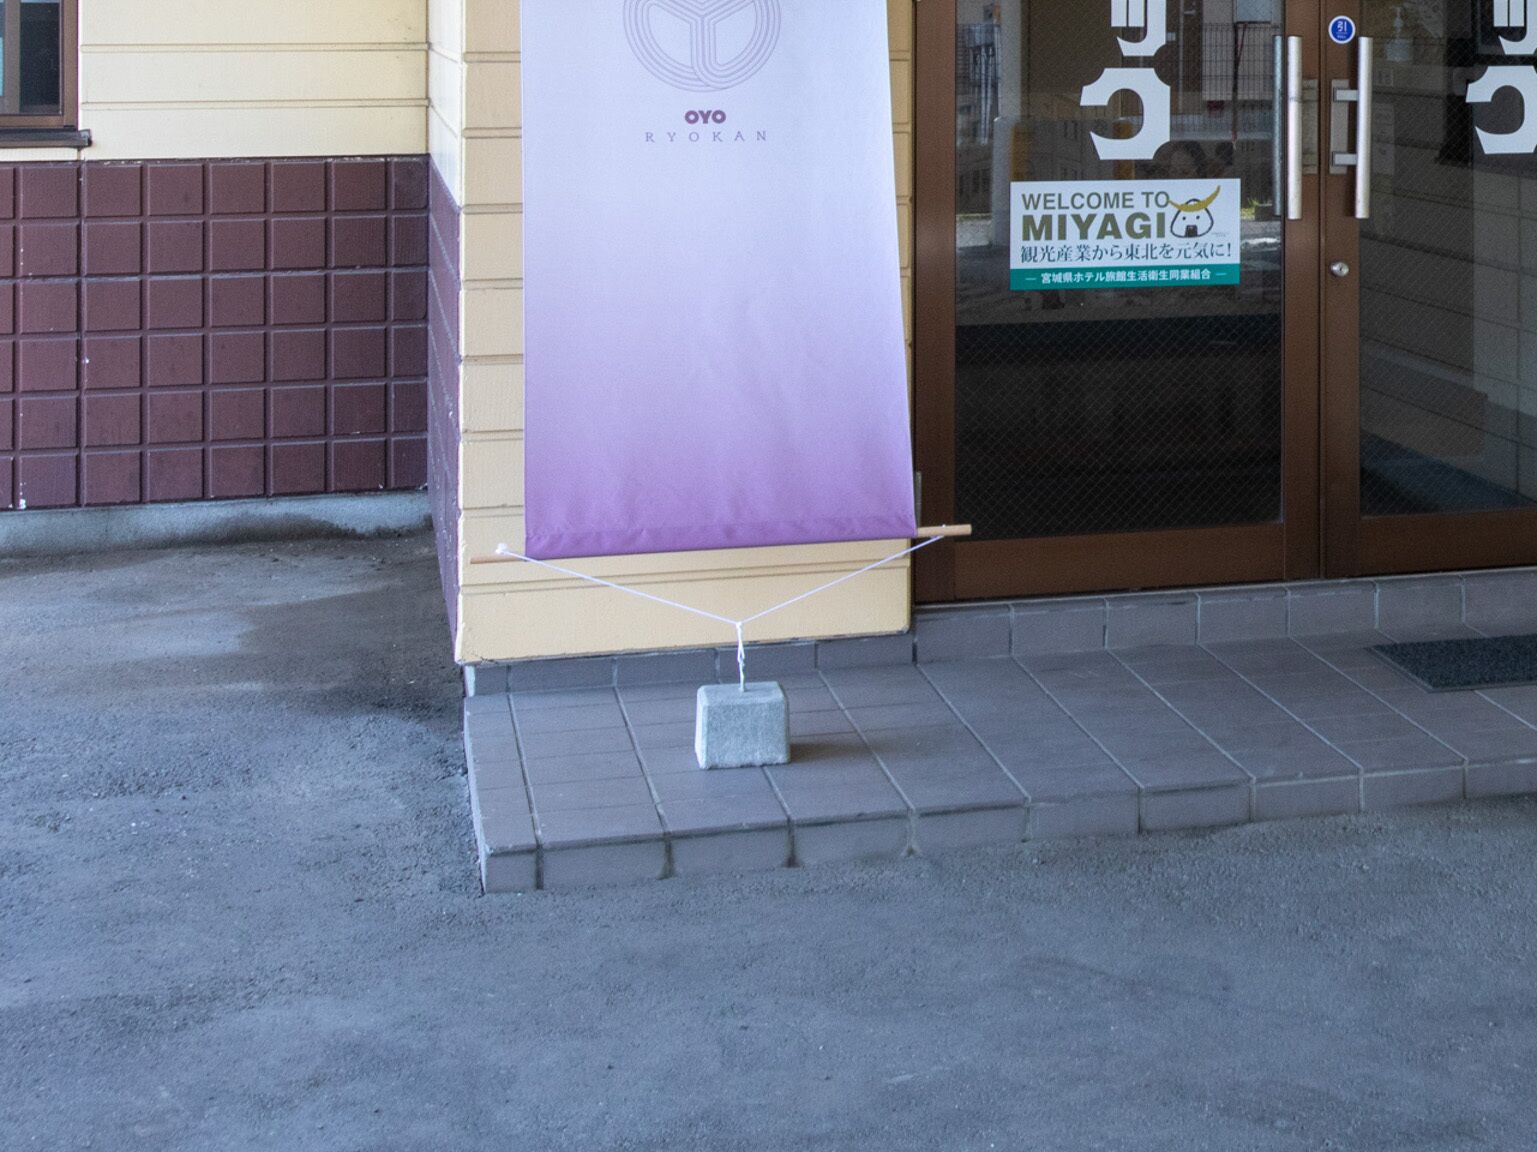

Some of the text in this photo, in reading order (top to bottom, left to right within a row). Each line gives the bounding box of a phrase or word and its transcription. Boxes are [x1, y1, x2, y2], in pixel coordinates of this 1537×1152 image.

[684, 109, 727, 124] OYO
[645, 130, 767, 143] RYOKAN
[1022, 190, 1170, 211] WELCOME TO
[1021, 211, 1167, 242] MIYAGI
